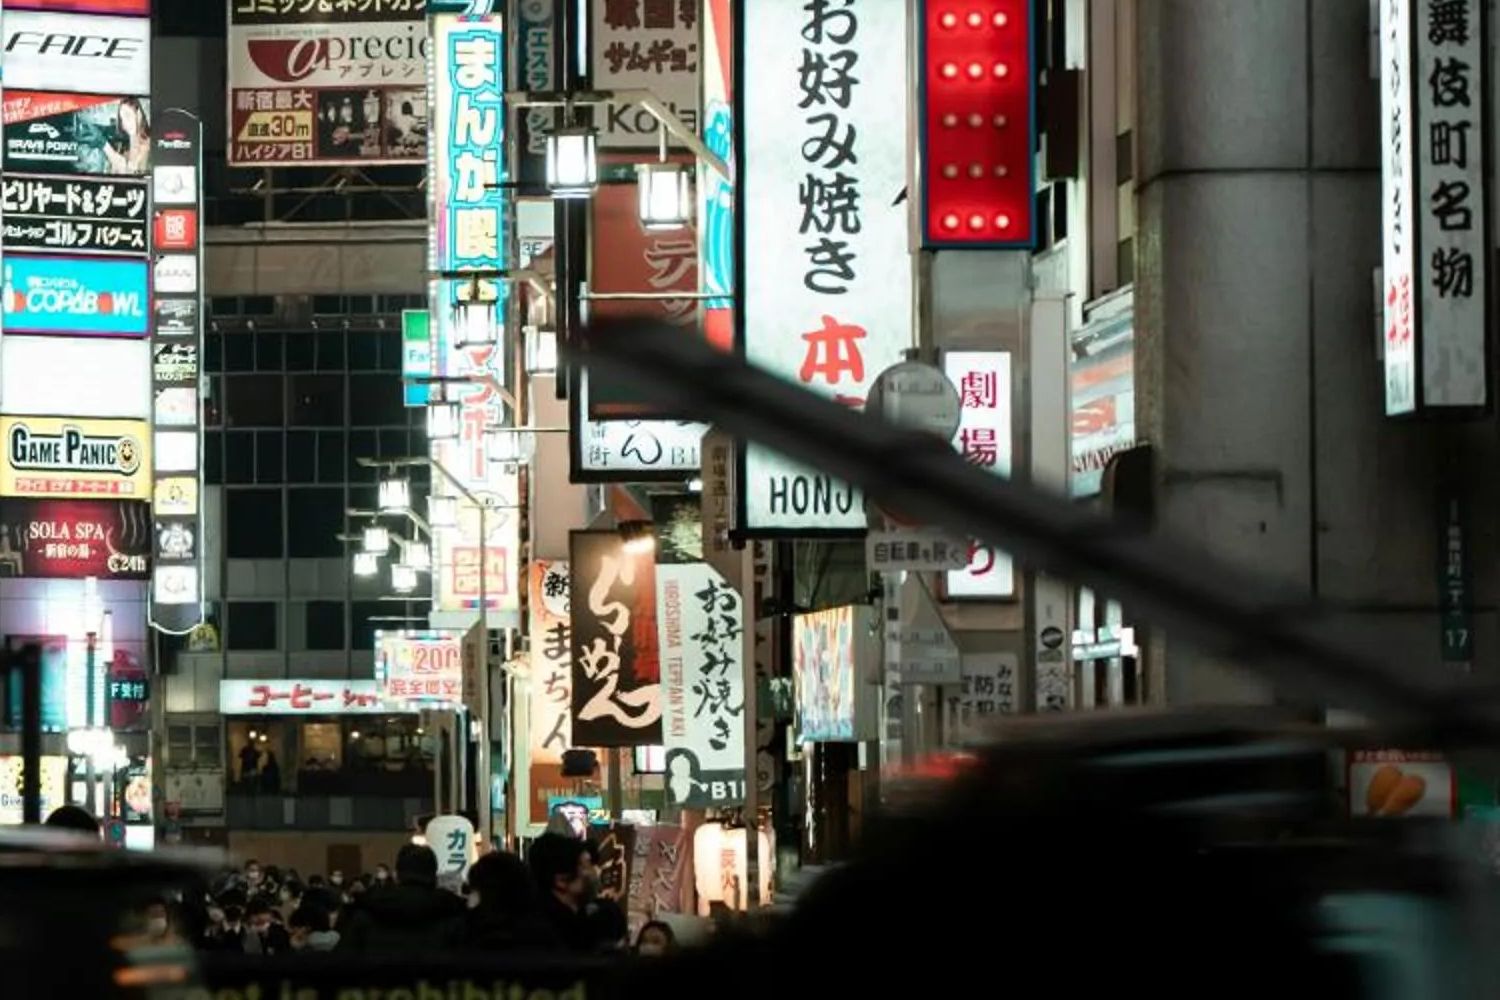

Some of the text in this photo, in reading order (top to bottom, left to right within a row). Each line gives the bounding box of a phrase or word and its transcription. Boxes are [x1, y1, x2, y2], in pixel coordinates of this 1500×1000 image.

[4, 30, 144, 61] FACE
[339, 64, 427, 78] アプレシ
[236, 88, 313, 111] 新宿最大
[1, 179, 146, 219] ビリヤード&ダーツ
[45, 220, 92, 247] ゴルフ
[95, 225, 145, 248] バグース
[10, 426, 117, 466] GAME PANIC
[958, 370, 999, 578] 劇場り
[769, 474, 867, 515] HONJ
[29, 521, 105, 541] SOLA SPA
[248, 683, 334, 709] コーヒー
